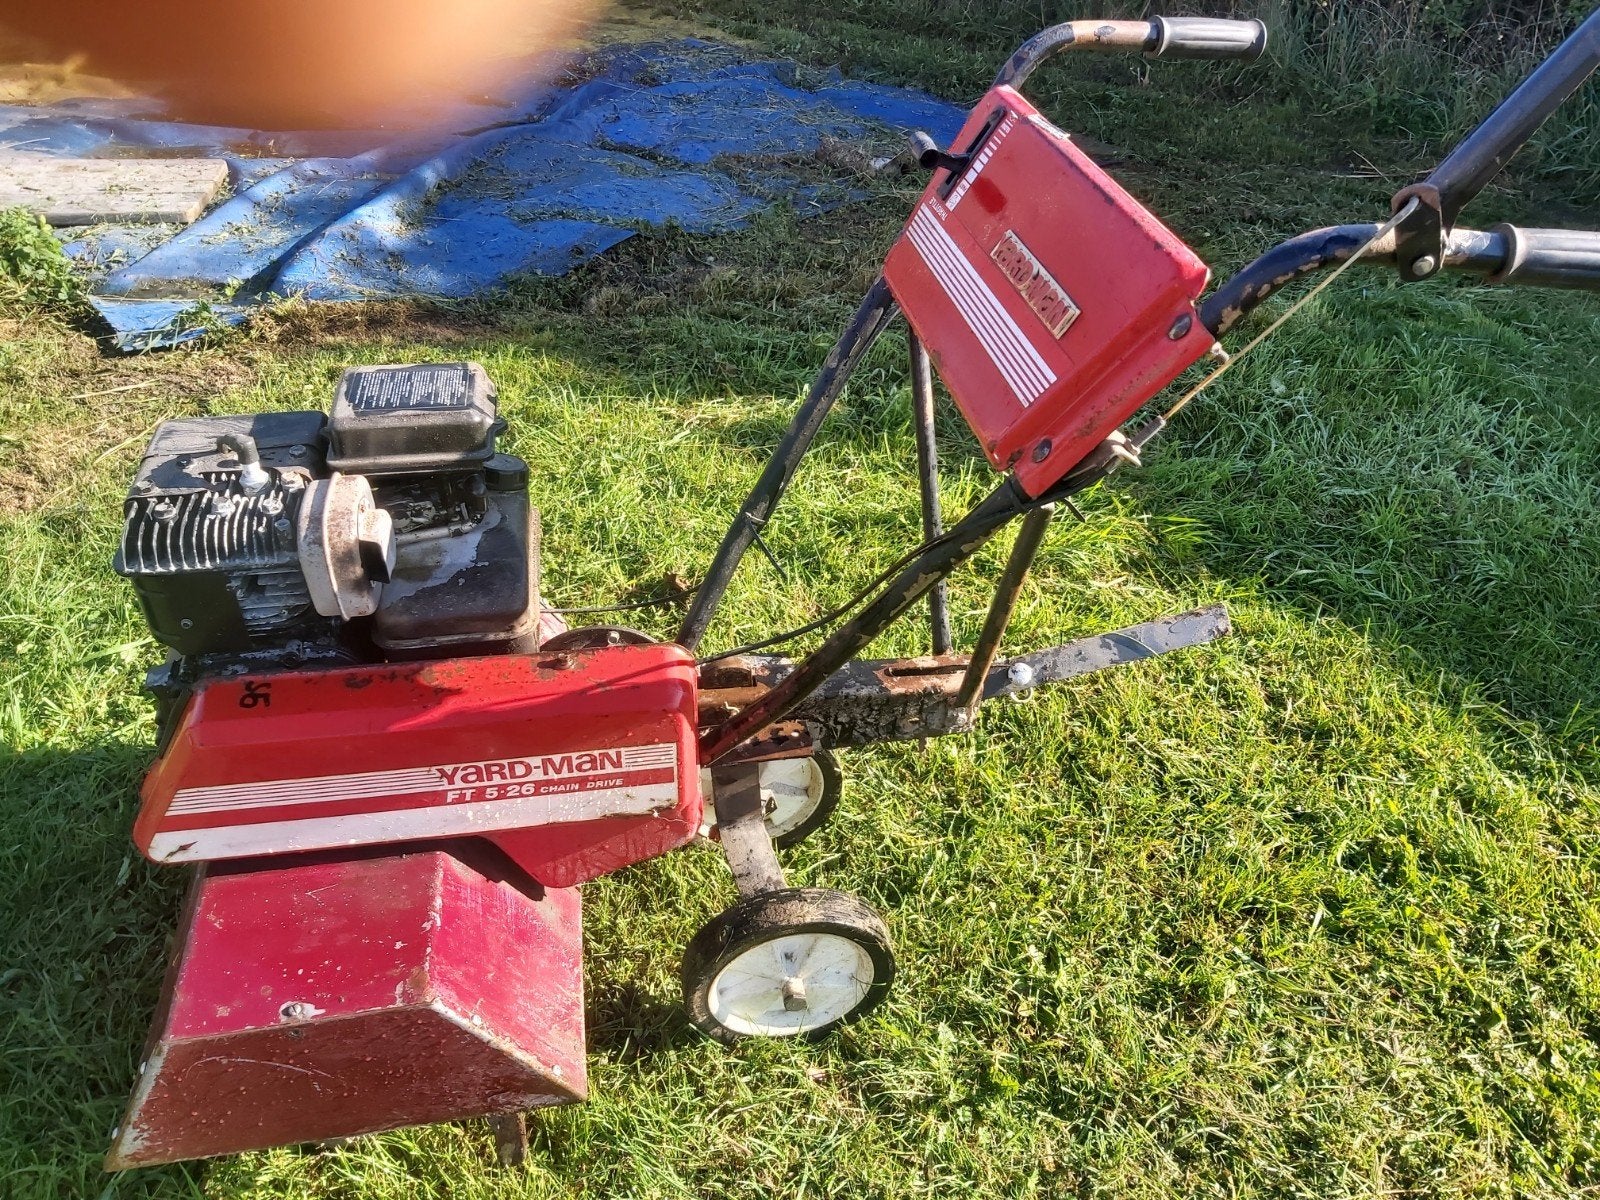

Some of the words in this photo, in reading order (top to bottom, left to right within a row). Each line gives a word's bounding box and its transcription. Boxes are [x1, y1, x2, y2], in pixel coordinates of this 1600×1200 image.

[446, 788, 477, 803] FT
[540, 782, 579, 793] CHAIN
[586, 778, 623, 789] DRIVE
